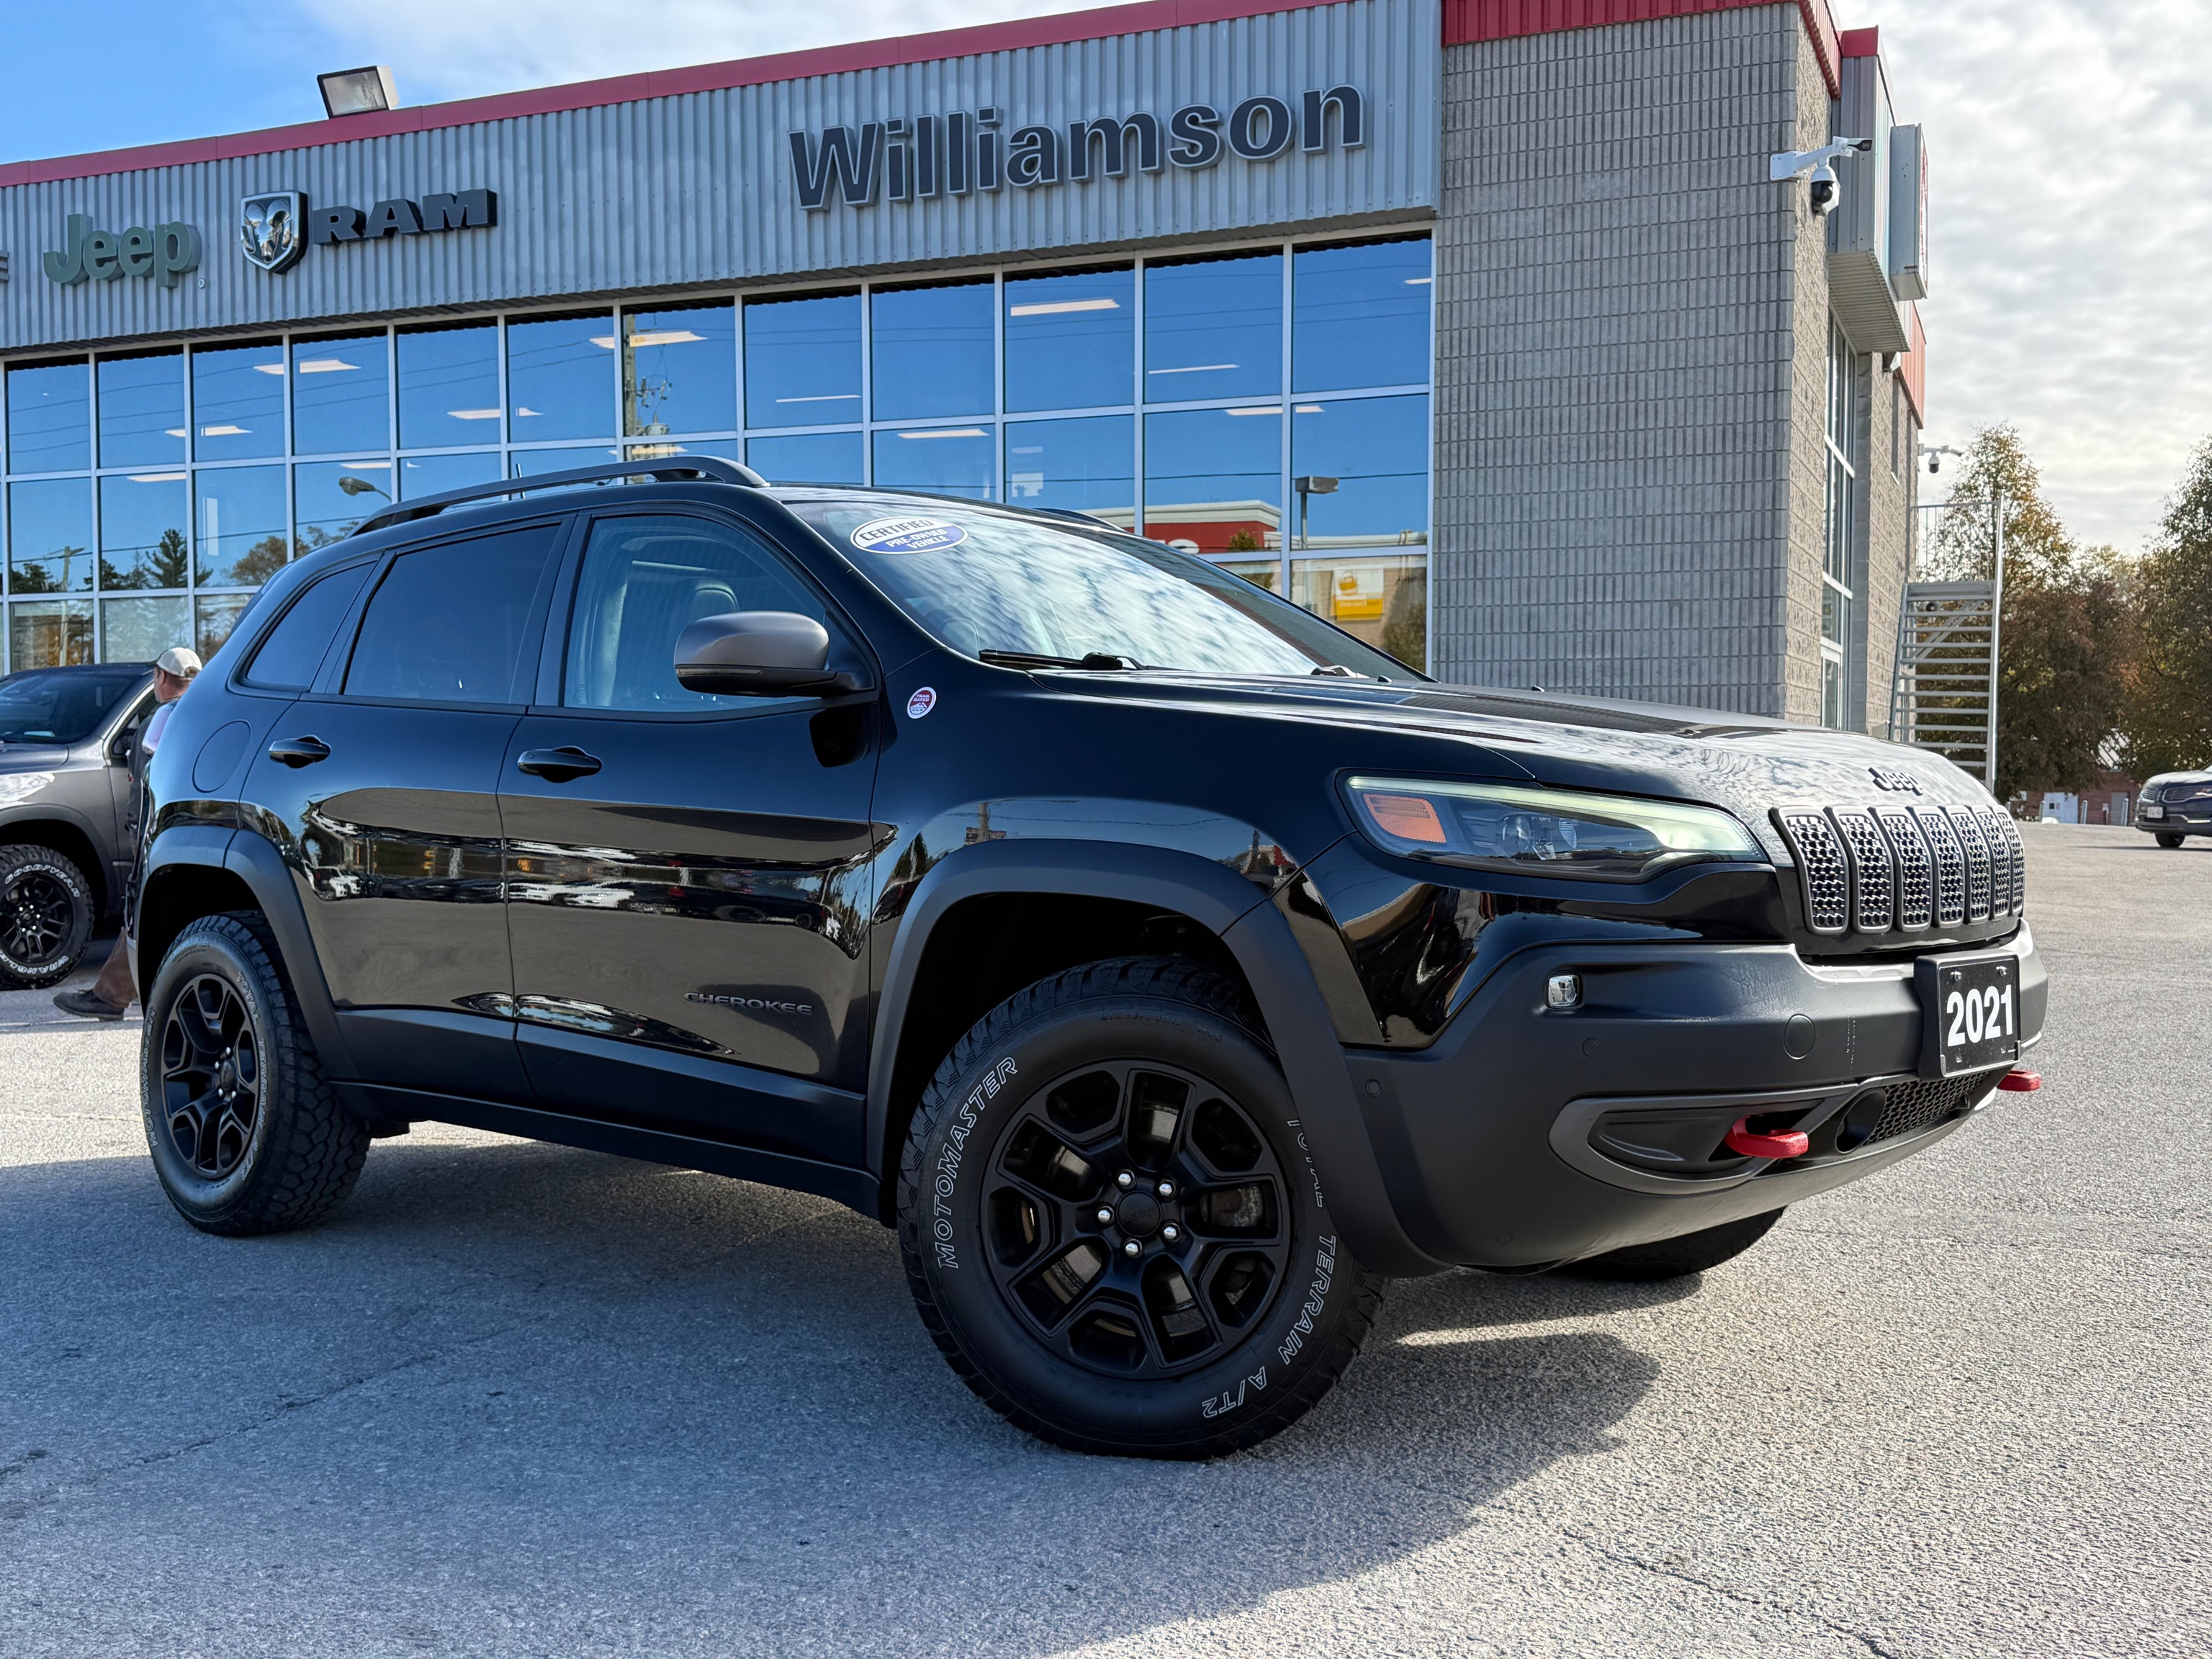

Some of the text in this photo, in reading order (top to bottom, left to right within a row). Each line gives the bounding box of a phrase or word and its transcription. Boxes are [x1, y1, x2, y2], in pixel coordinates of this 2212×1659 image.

[787, 84, 1367, 212] Williamson
[312, 189, 497, 245] RAM
[43, 214, 202, 288] Jeep
[859, 519, 935, 541] CERTIFIED
[886, 529, 948, 548] PRE-OWNED
[906, 536, 950, 549] VEHICLE
[1868, 767, 1923, 796] Jeep
[4, 863, 81, 898] GOODYEAR
[0, 948, 69, 975] WRANGLE
[684, 992, 814, 1016] CHEROKEE
[1946, 984, 2013, 1047] 2021
[237, 971, 261, 1026] TOTAL
[257, 1038, 269, 1130] TERRAIN
[934, 1056, 1019, 1269] MOTOMASTER
[1278, 1235, 1337, 1365] TERRAIN
[1201, 1365, 1268, 1419] A/T2
